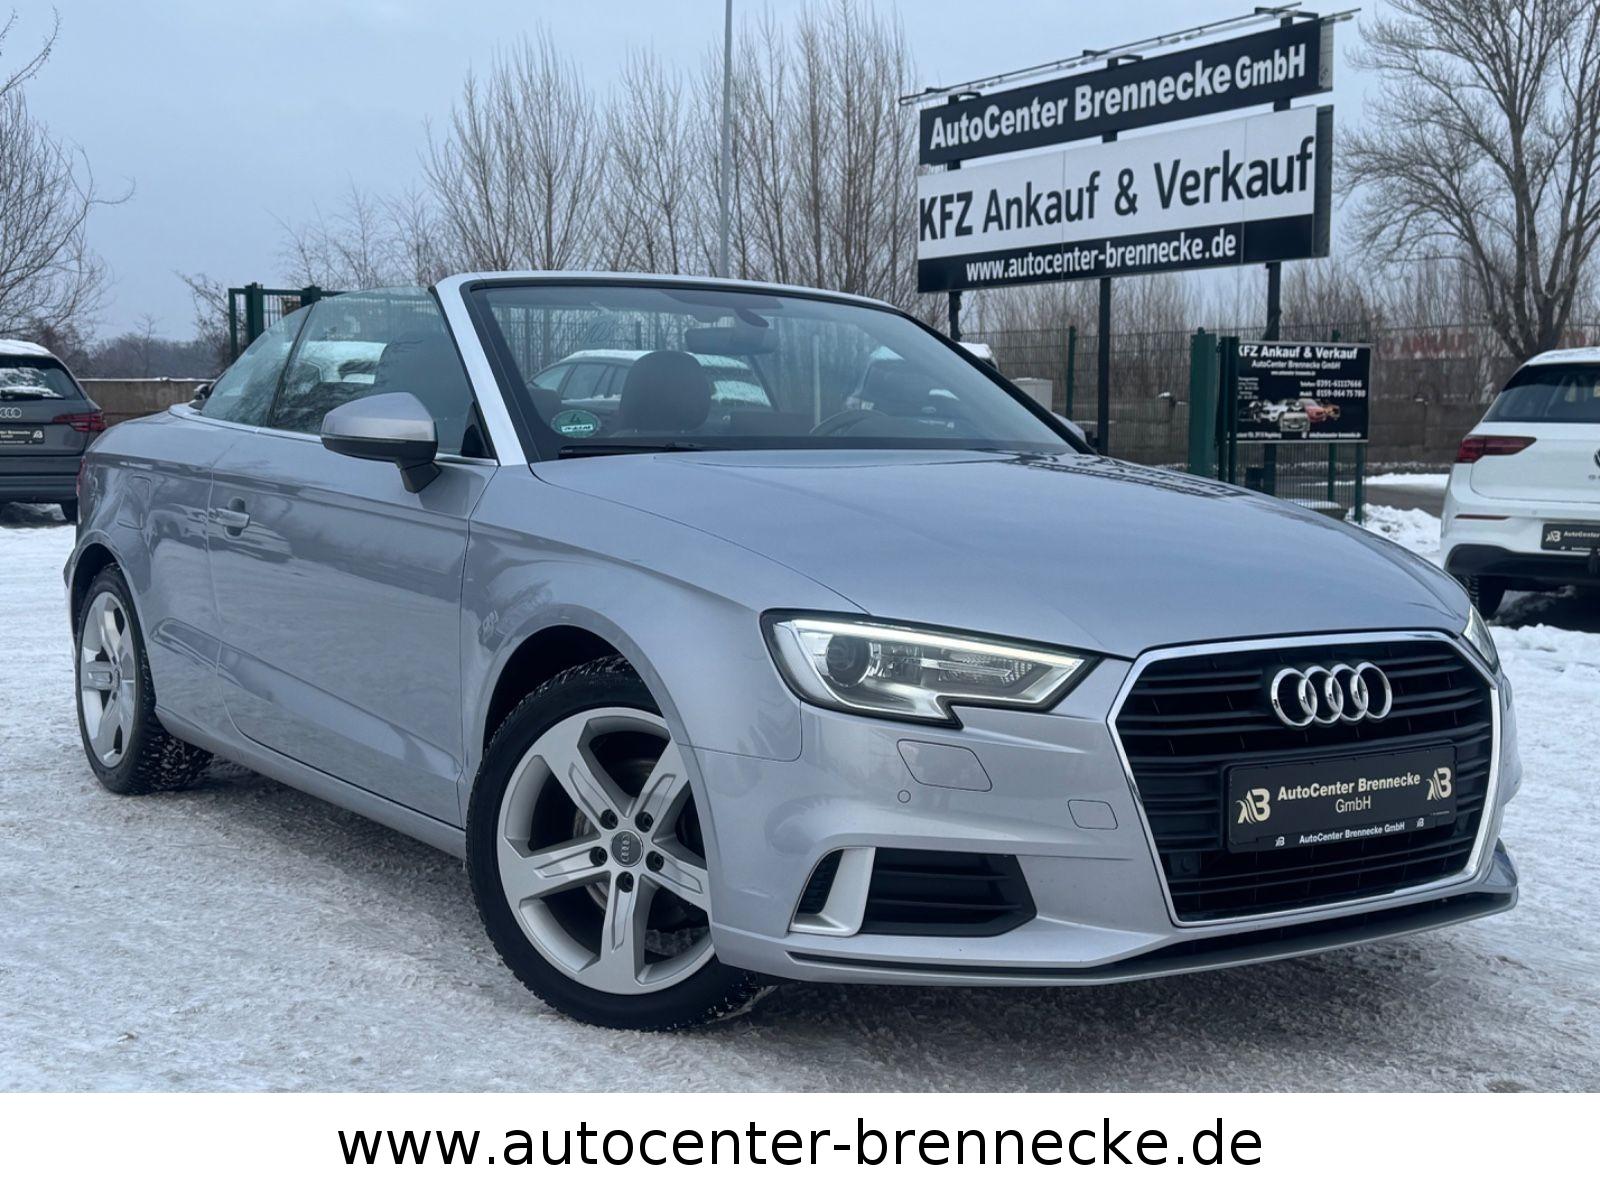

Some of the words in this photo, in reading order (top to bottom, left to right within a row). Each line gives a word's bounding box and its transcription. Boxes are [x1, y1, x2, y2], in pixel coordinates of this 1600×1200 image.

[930, 97, 1068, 150] AutoCenter
[1075, 60, 1231, 122] Brennecke
[1235, 44, 1306, 90] GmbH
[920, 190, 974, 242] KFZ
[982, 171, 1100, 233] Ankauf
[1114, 168, 1138, 216] &
[1153, 136, 1315, 210] Verkauf
[966, 228, 1237, 282] www.autocenter-brennecke.de
[1261, 345, 1300, 358] Ankauf
[1303, 346, 1313, 358] &
[1315, 347, 1358, 359] Verkauf
[1278, 781, 1354, 802] AutoCenter
[1358, 772, 1421, 792] Brennecke
[1335, 797, 1371, 814] GmbH
[1299, 831, 1343, 845] AutoCenter
[1345, 825, 1383, 838] Brennecke
[1384, 822, 1406, 834] GmbH
